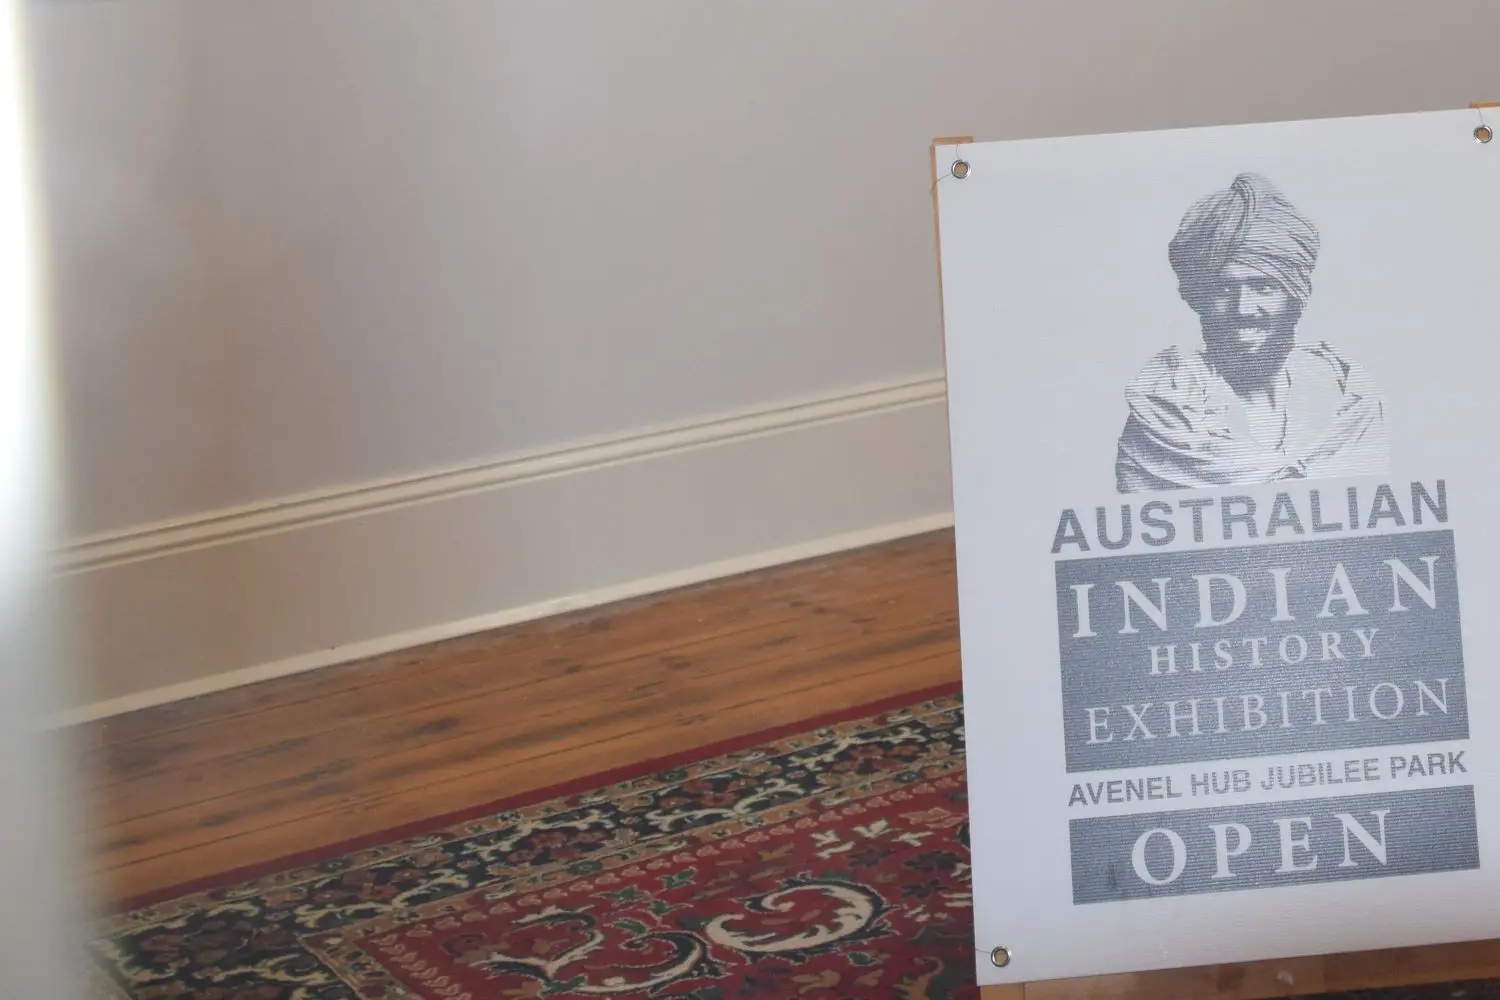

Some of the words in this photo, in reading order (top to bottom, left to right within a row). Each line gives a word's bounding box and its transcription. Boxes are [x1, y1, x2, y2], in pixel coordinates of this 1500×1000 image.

[1050, 479, 1449, 554] AUSTRALIAN
[1070, 555, 1441, 639] INDIAN
[1148, 627, 1380, 675] HISTORY
[1085, 678, 1449, 745] EXHIBITION
[1068, 776, 1182, 807] AVENEL
[1190, 768, 1252, 797] HUB
[1260, 757, 1380, 790] JUBILEE
[1389, 750, 1468, 779] PARK
[1131, 808, 1391, 886] OPEN
